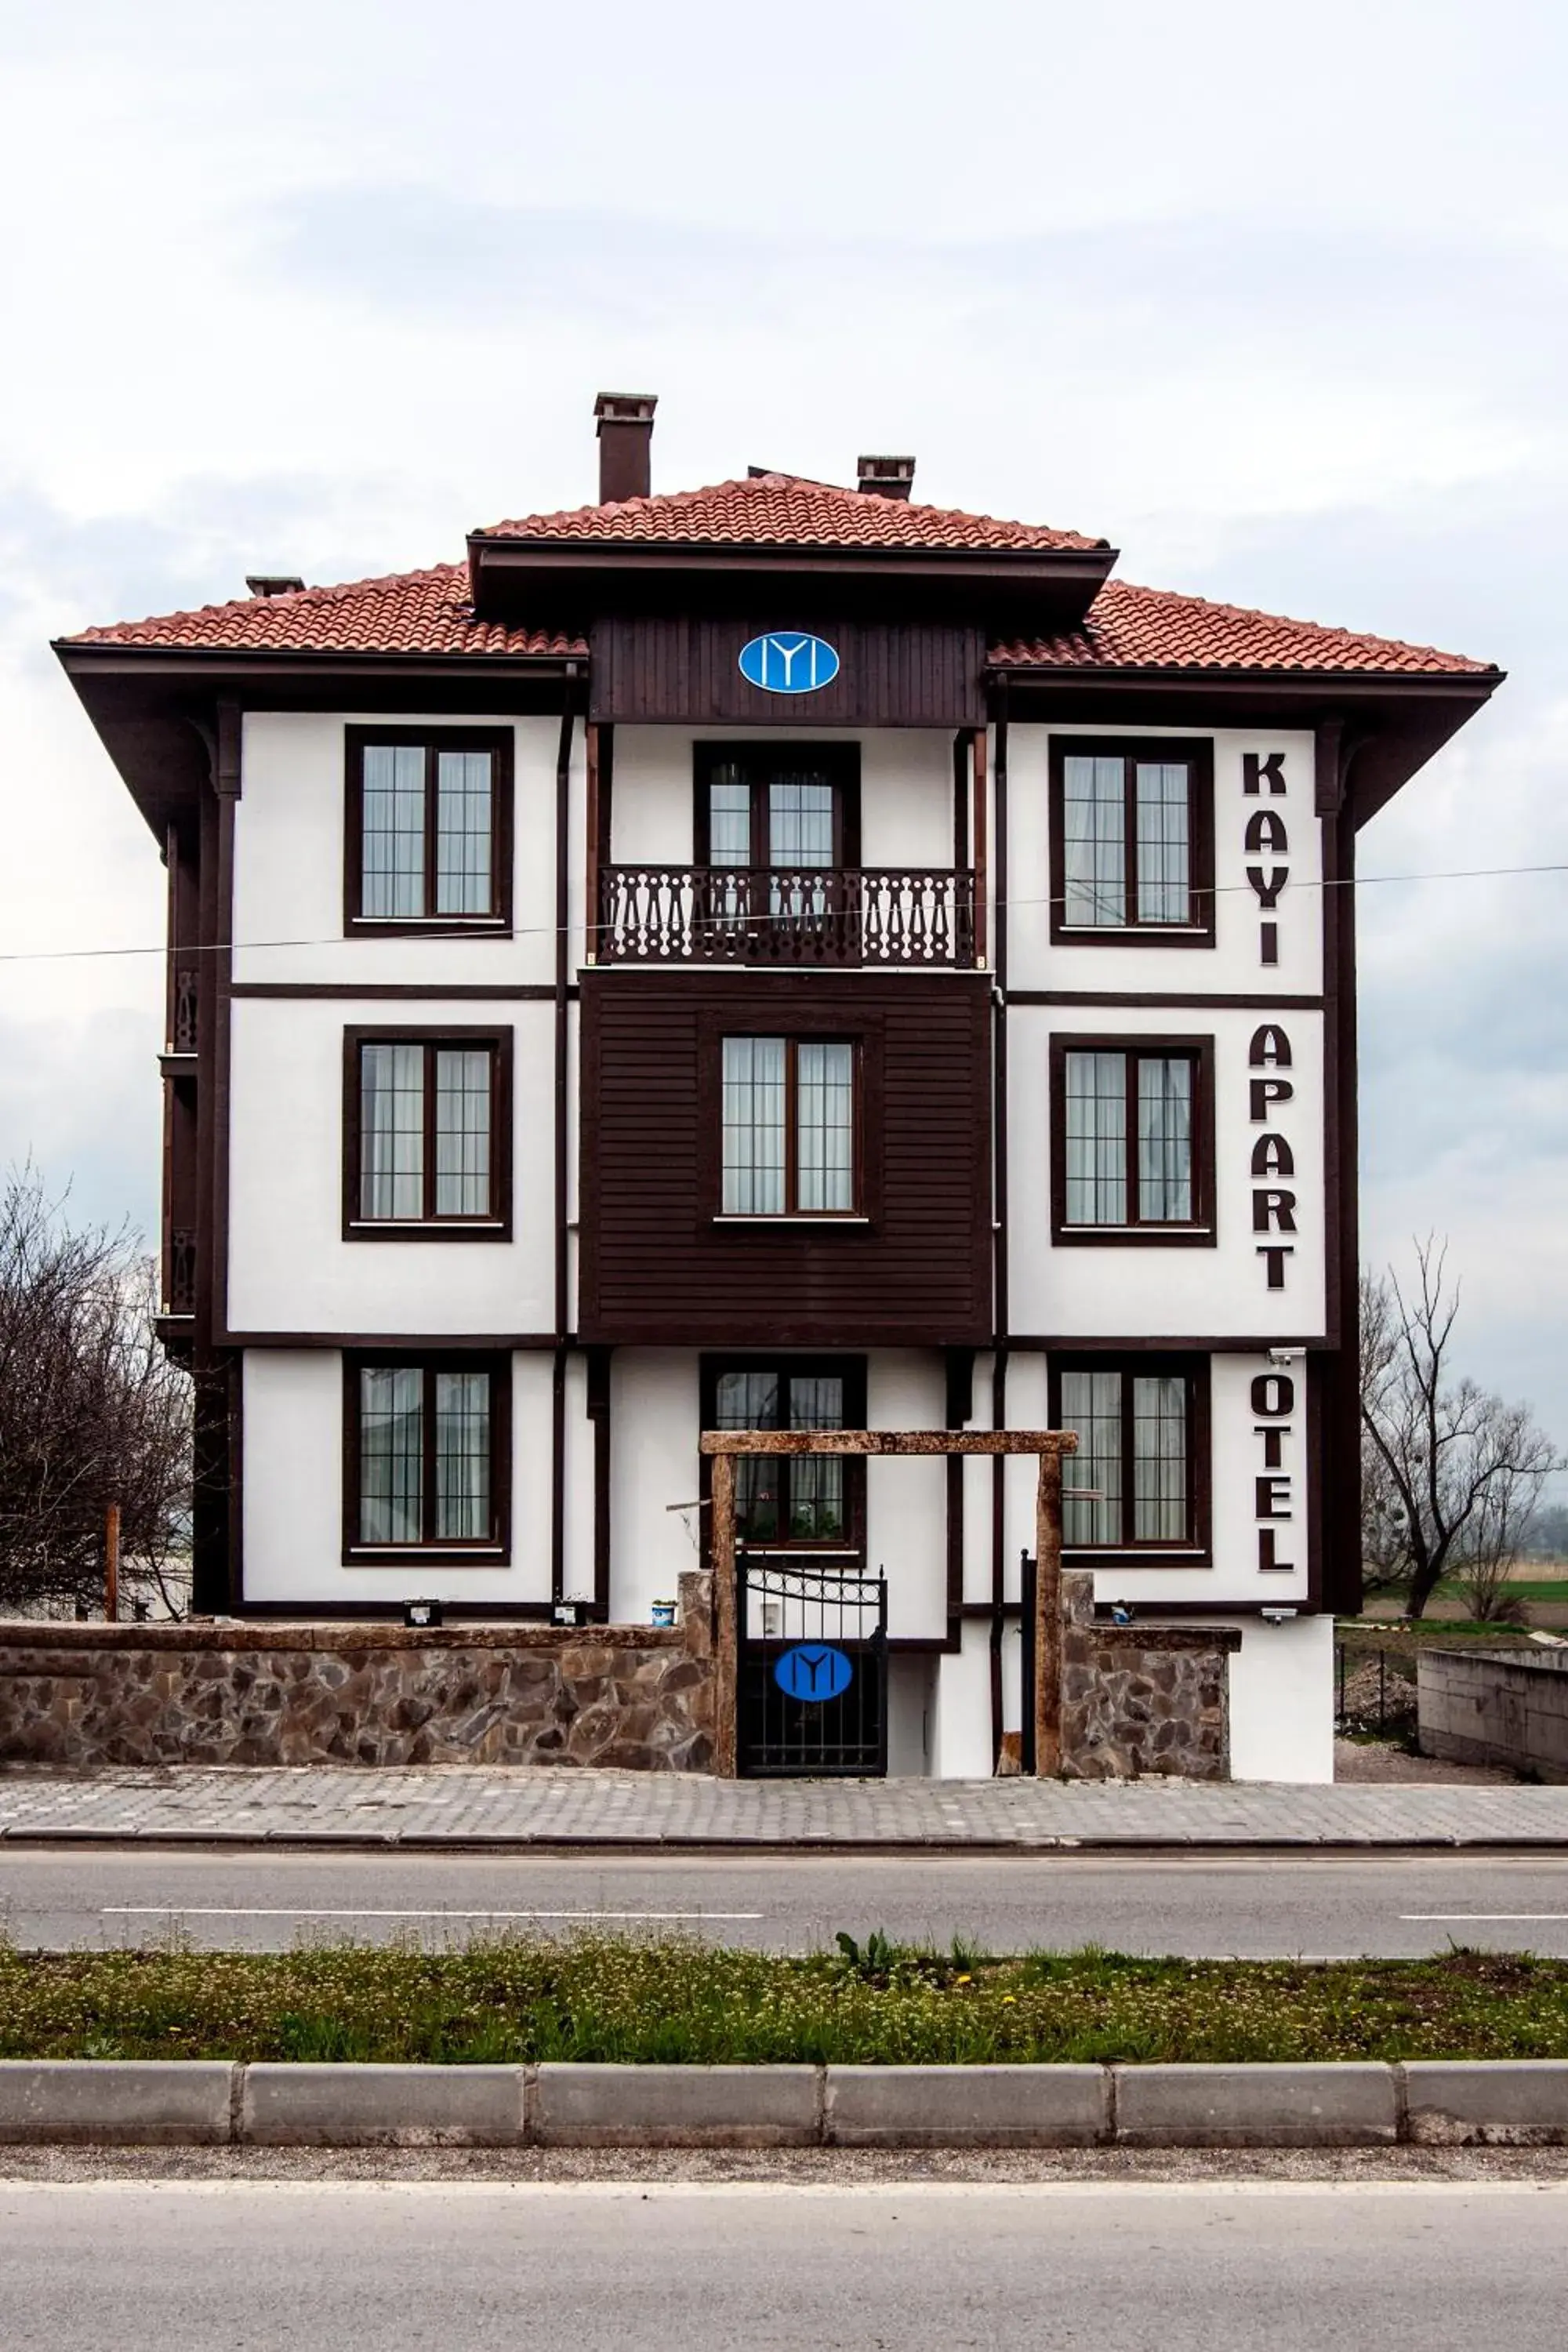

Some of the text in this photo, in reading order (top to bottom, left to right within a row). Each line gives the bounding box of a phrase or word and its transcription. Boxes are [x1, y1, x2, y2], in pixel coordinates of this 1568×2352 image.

[1242, 752, 1298, 1573] KAYI APART OTEL
